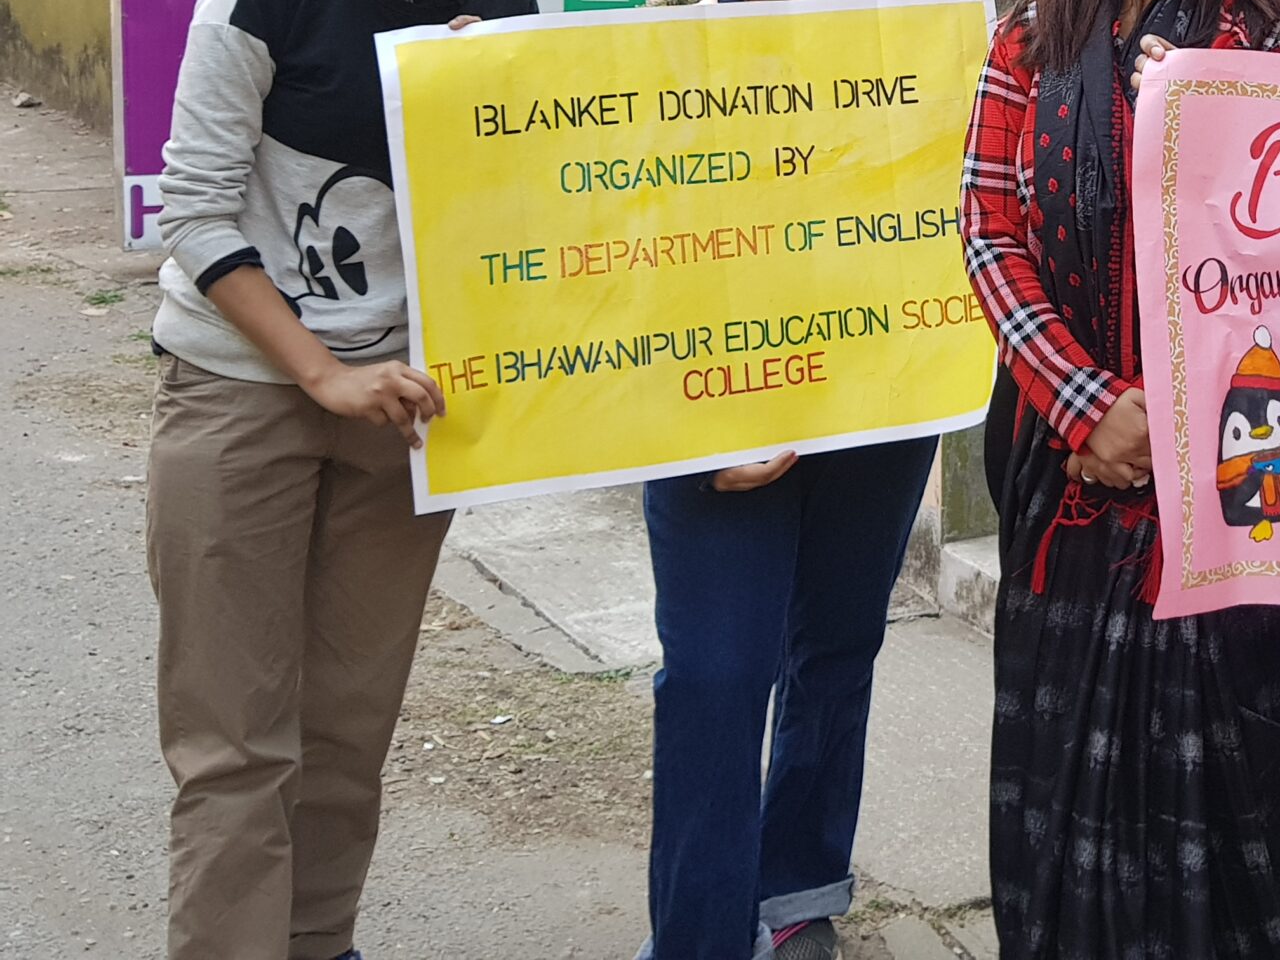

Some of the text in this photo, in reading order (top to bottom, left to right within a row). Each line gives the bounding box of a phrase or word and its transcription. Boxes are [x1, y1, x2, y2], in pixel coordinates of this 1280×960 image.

[474, 75, 920, 137] BLANKET DONATION DRIVE
[561, 145, 815, 193] ORGANIZED BY
[481, 207, 960, 285] THE DEPARTMENT OF ENGLISH
[429, 293, 985, 395] THE BHAWANIPUR EDUCATION SOCIE
[683, 352, 828, 400] COLLEGE
